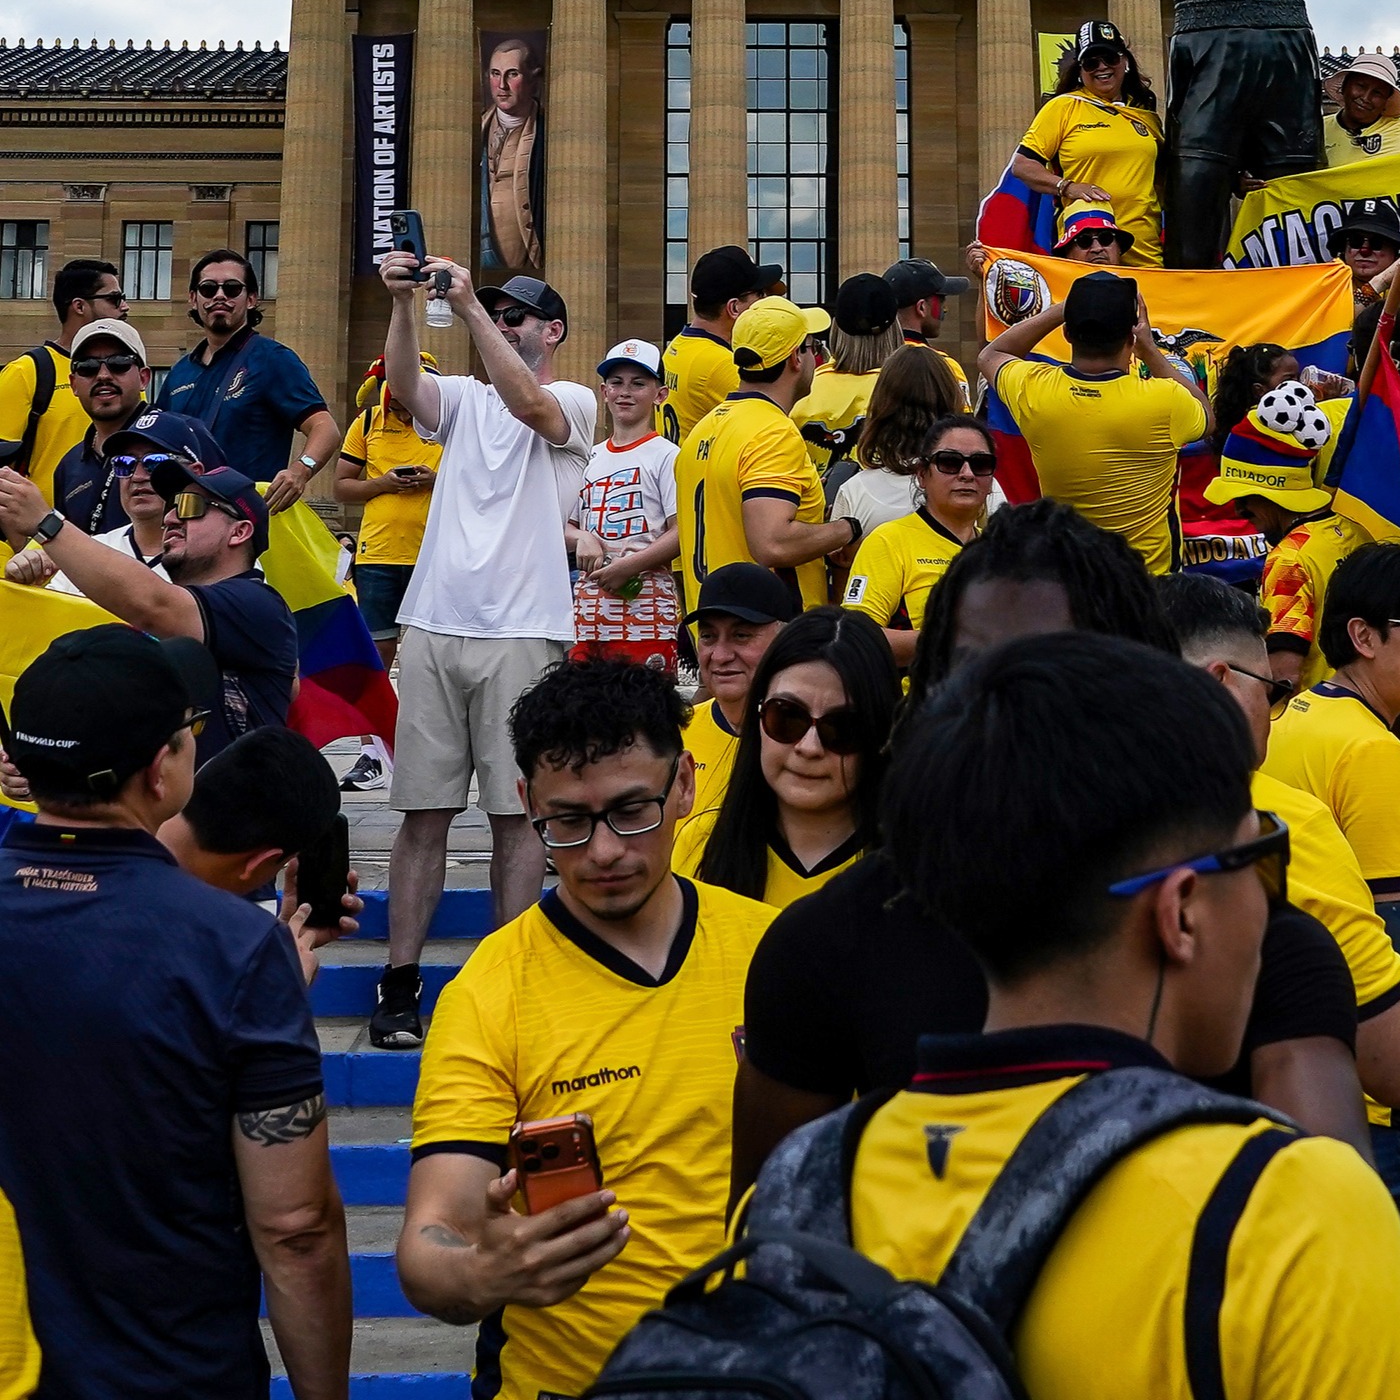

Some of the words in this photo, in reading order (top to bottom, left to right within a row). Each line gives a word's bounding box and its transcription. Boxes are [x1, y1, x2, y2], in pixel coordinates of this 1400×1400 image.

[373, 43, 395, 134] ARTISTS
[374, 138, 395, 165] OF
[373, 169, 395, 248] NATION
[1225, 466, 1286, 487] ECUADOR
[1234, 537, 1249, 560] A
[551, 1064, 641, 1096] marathon
